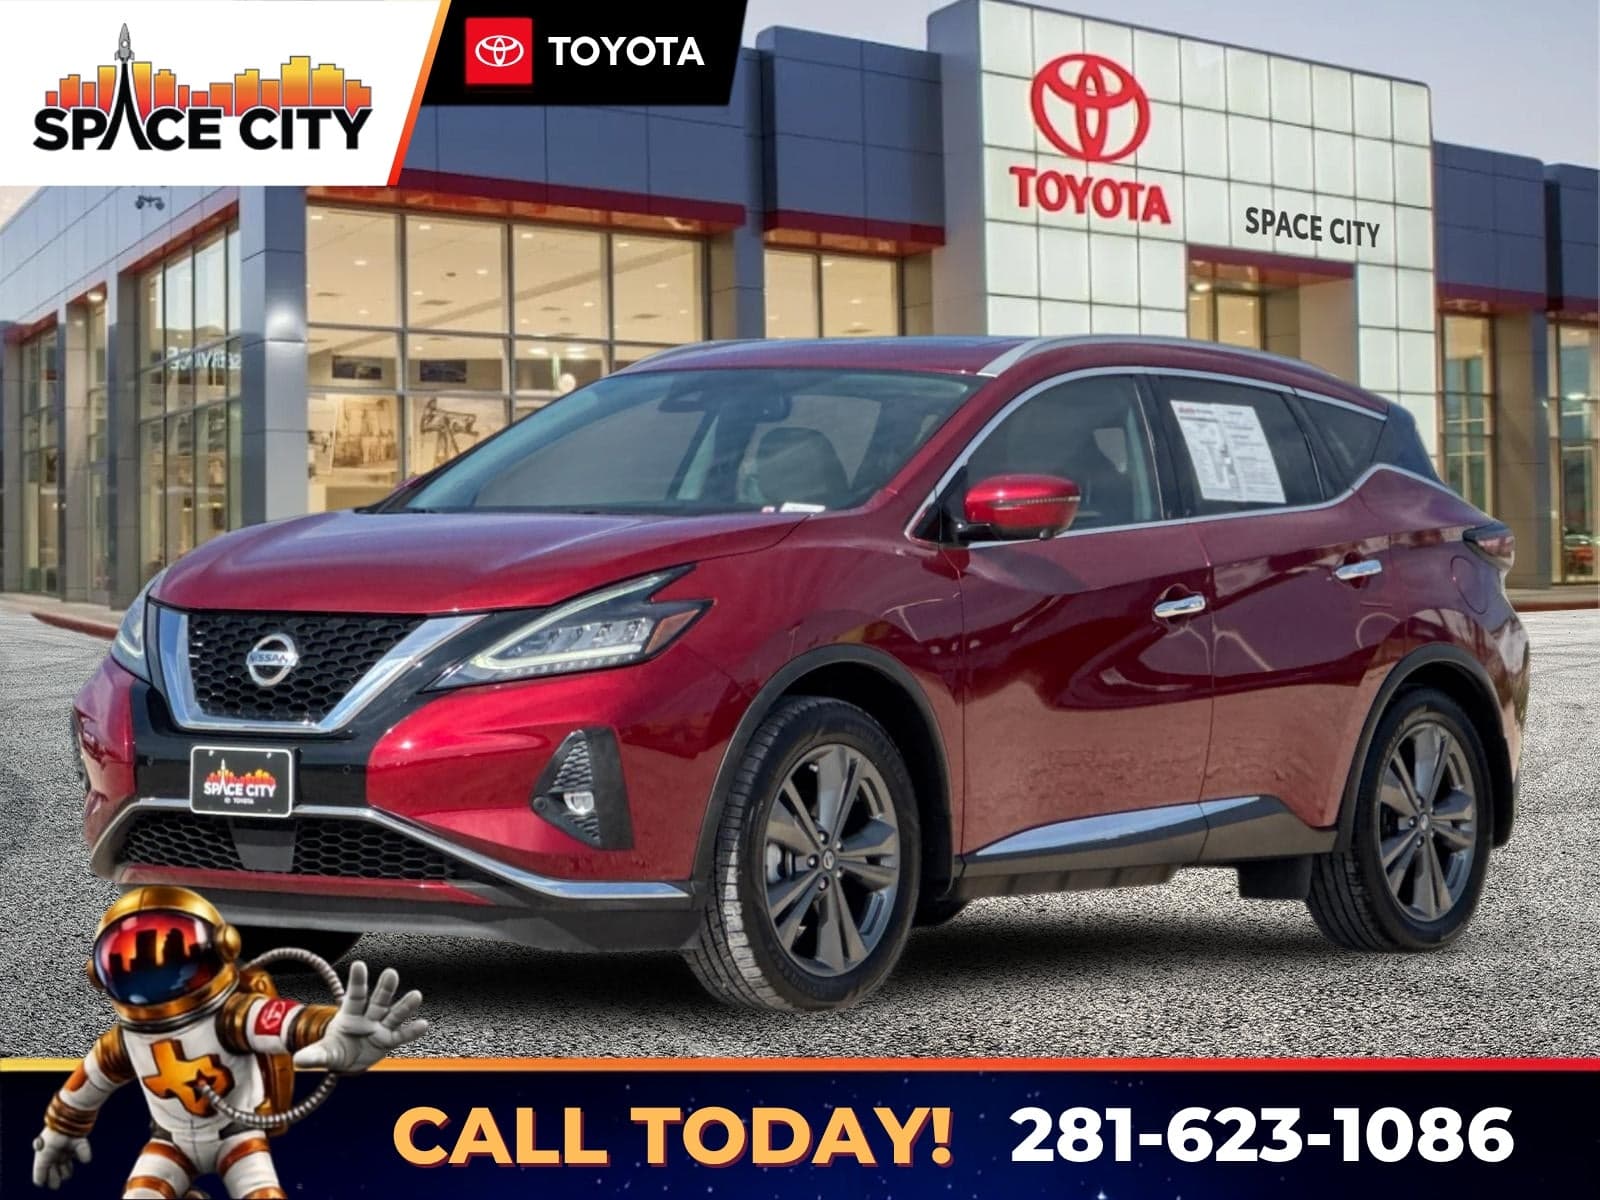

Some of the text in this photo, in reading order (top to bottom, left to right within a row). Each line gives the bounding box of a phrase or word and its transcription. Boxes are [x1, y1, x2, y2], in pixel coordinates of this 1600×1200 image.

[1009, 166, 1171, 224] TOYOTA
[1245, 207, 1380, 248] SPACE CITY
[249, 652, 290, 664] NISSAN
[203, 781, 276, 798] SPACE CITY
